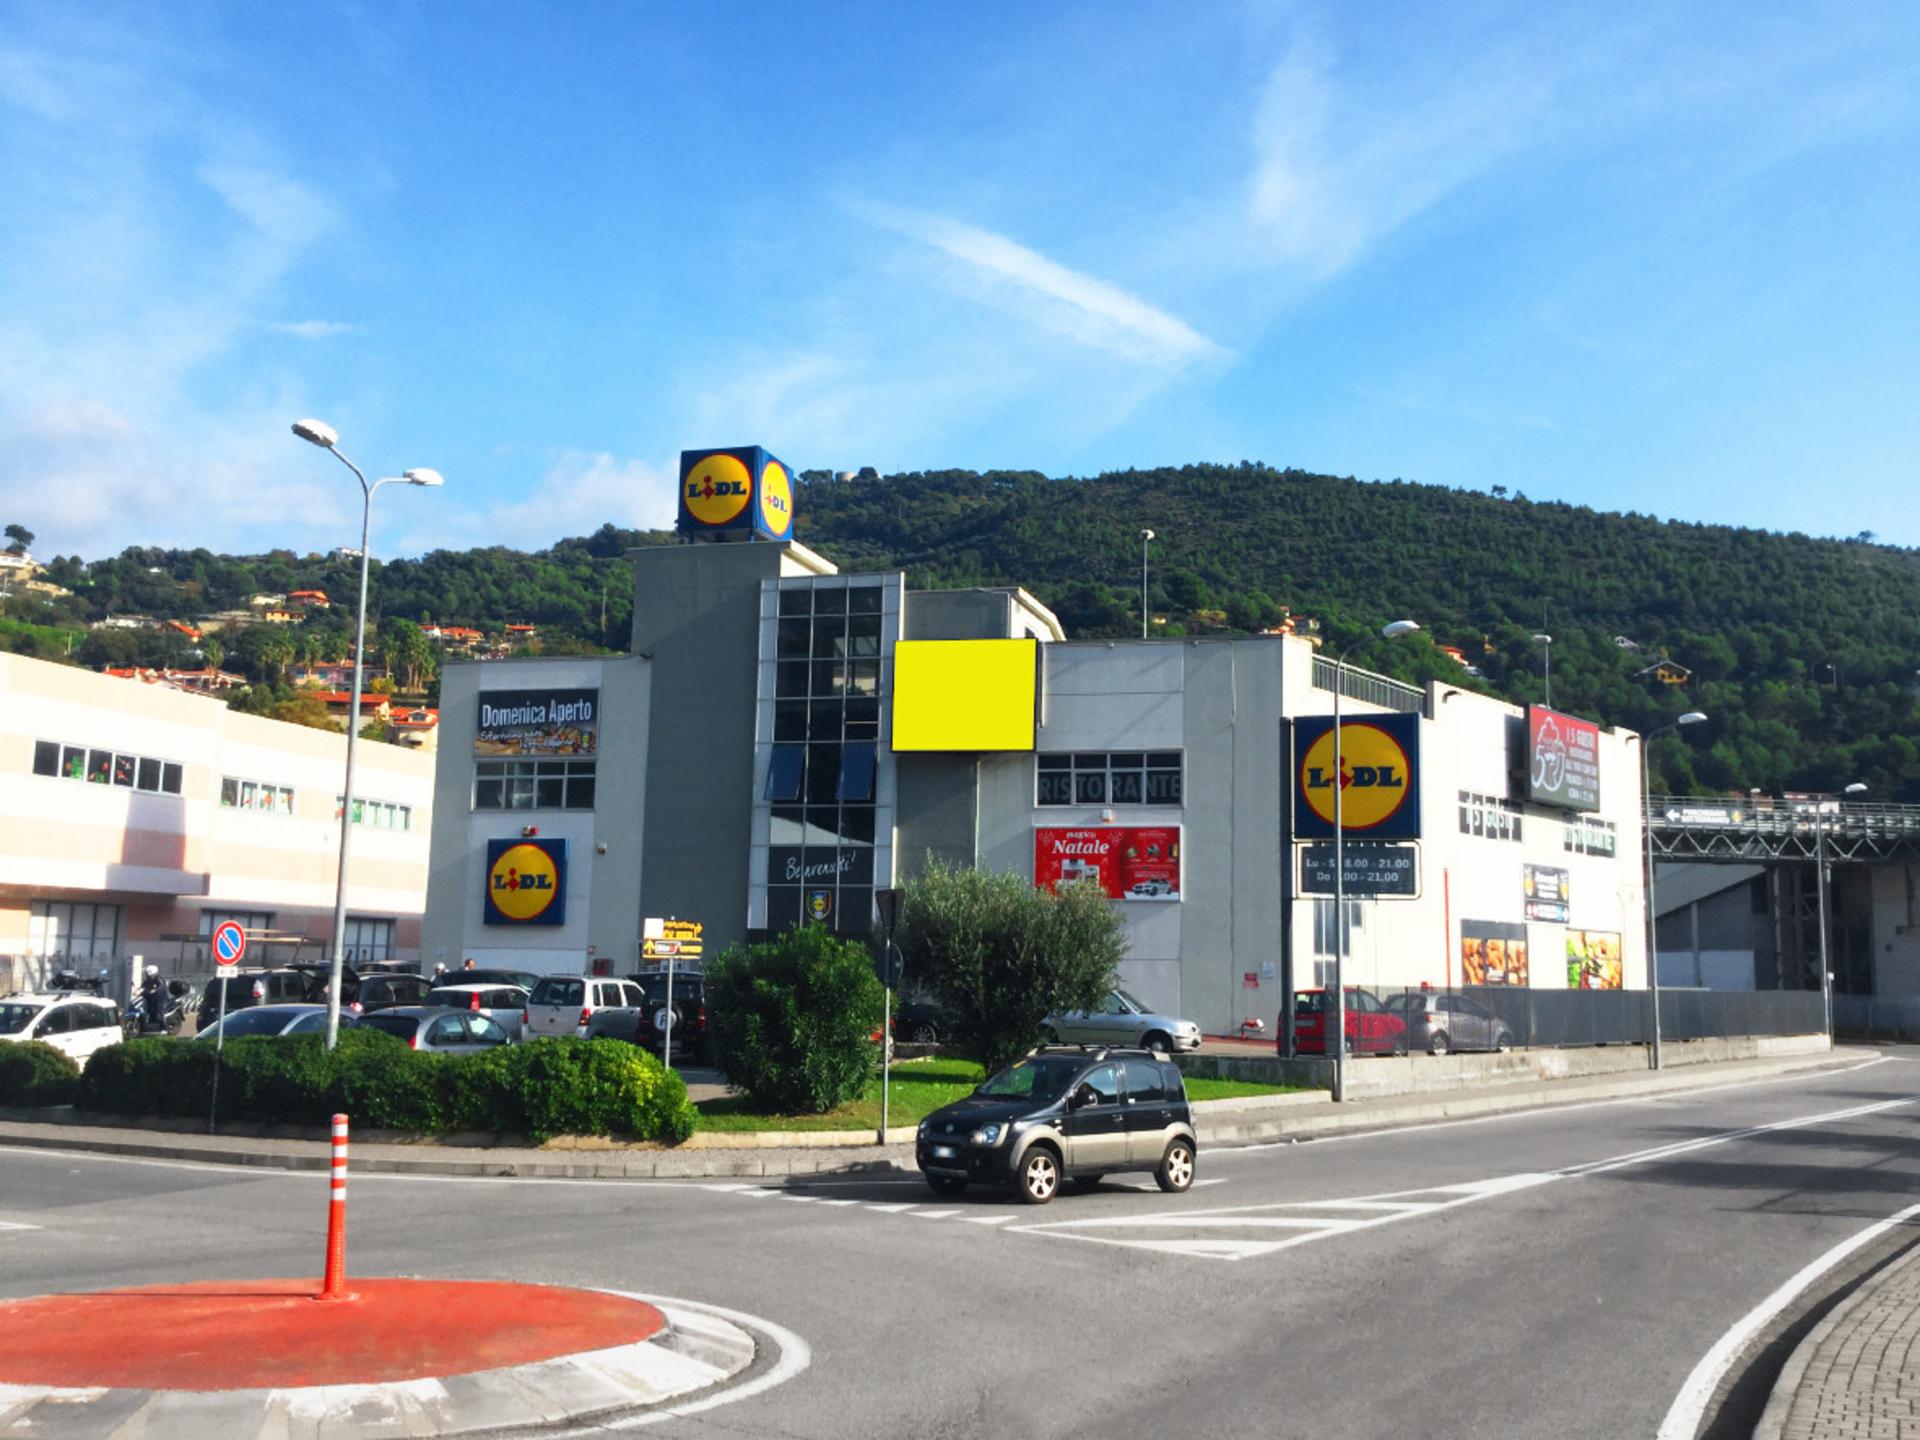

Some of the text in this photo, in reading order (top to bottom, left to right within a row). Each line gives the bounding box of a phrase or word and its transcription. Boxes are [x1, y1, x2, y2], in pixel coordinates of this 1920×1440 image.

[482, 698, 592, 727] Domenica Aperto
[1052, 840, 1110, 854] Natale
[1306, 858, 1319, 868] Lu
[1378, 858, 1410, 869] 21.00
[1367, 872, 1399, 883] 21.00
